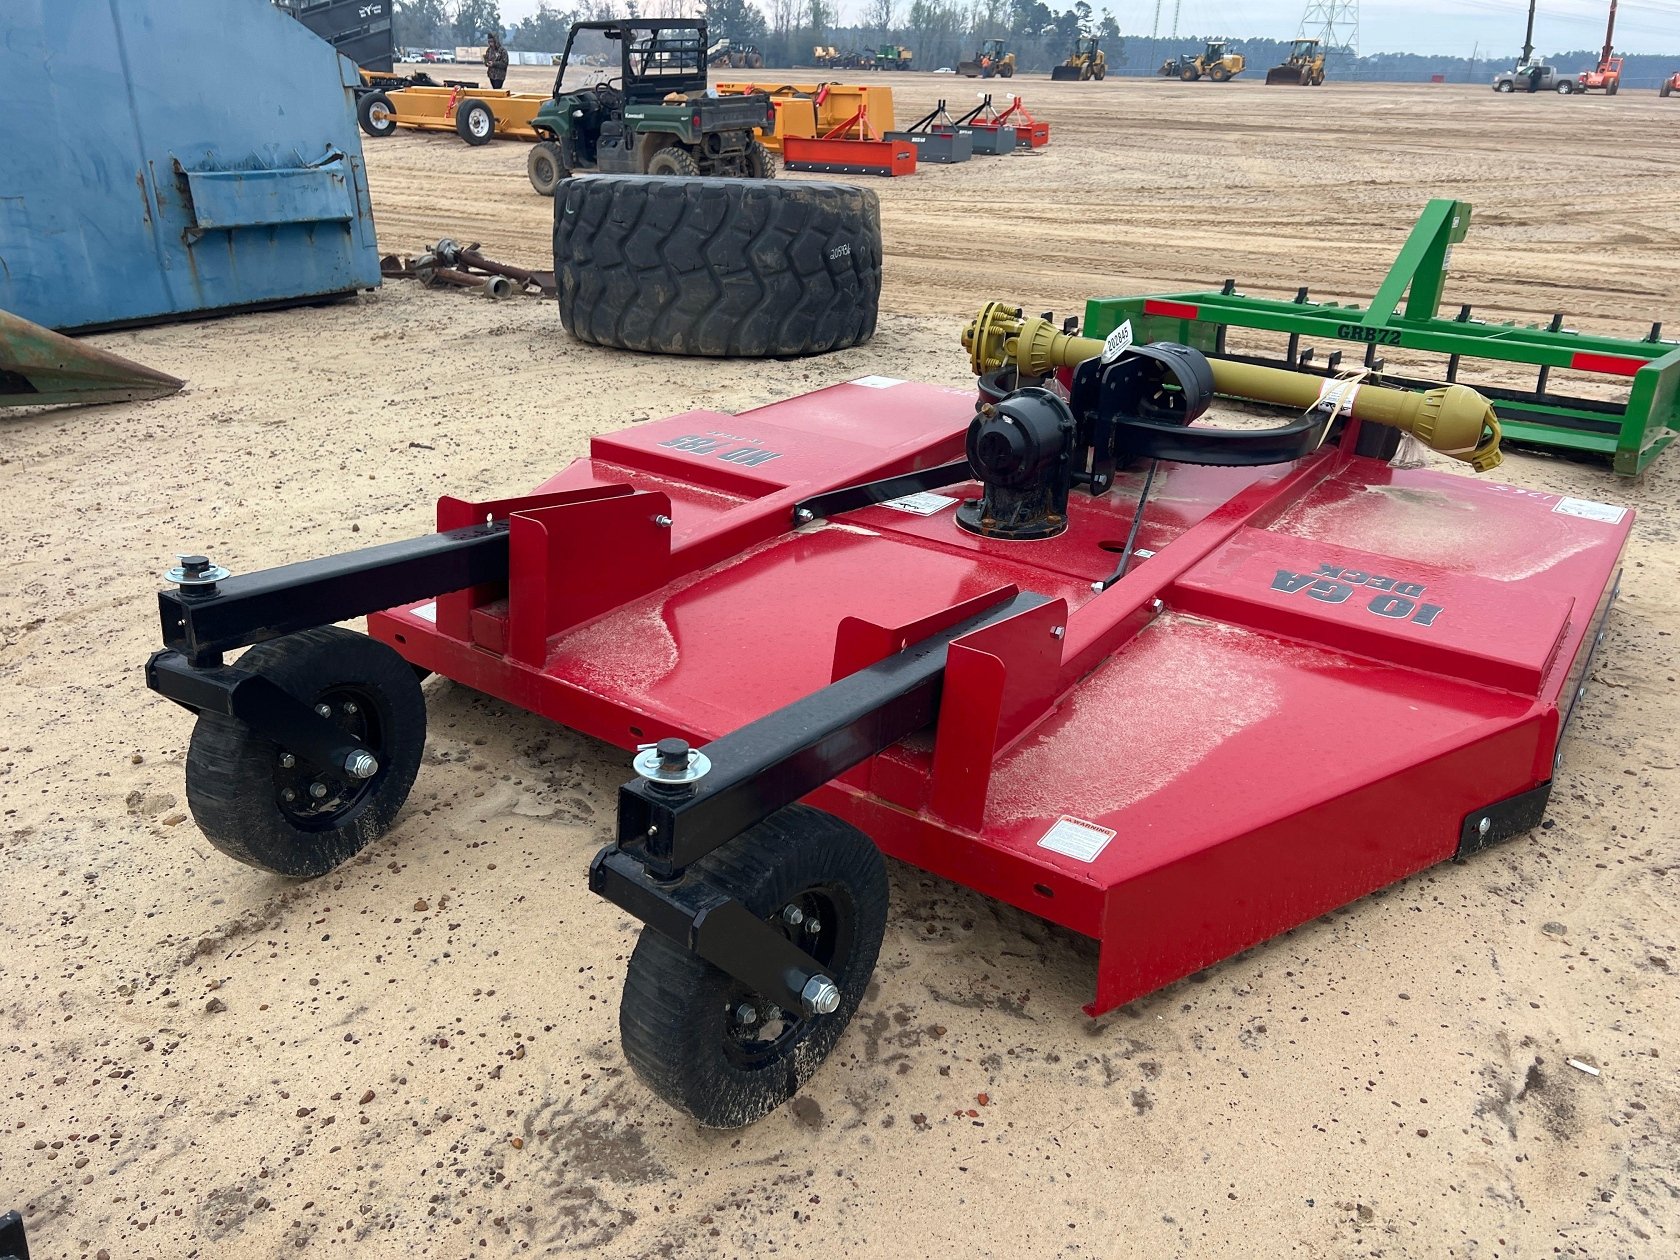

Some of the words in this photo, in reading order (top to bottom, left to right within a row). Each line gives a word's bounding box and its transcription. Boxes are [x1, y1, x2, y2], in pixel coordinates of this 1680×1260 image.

[1108, 327, 1129, 352] 202845
[1338, 324, 1402, 345] GRB72
[1270, 569, 1354, 604] GA
[1311, 563, 1428, 598] DECK
[1366, 594, 1445, 627] 10
[1074, 819, 1110, 836] WARNING
